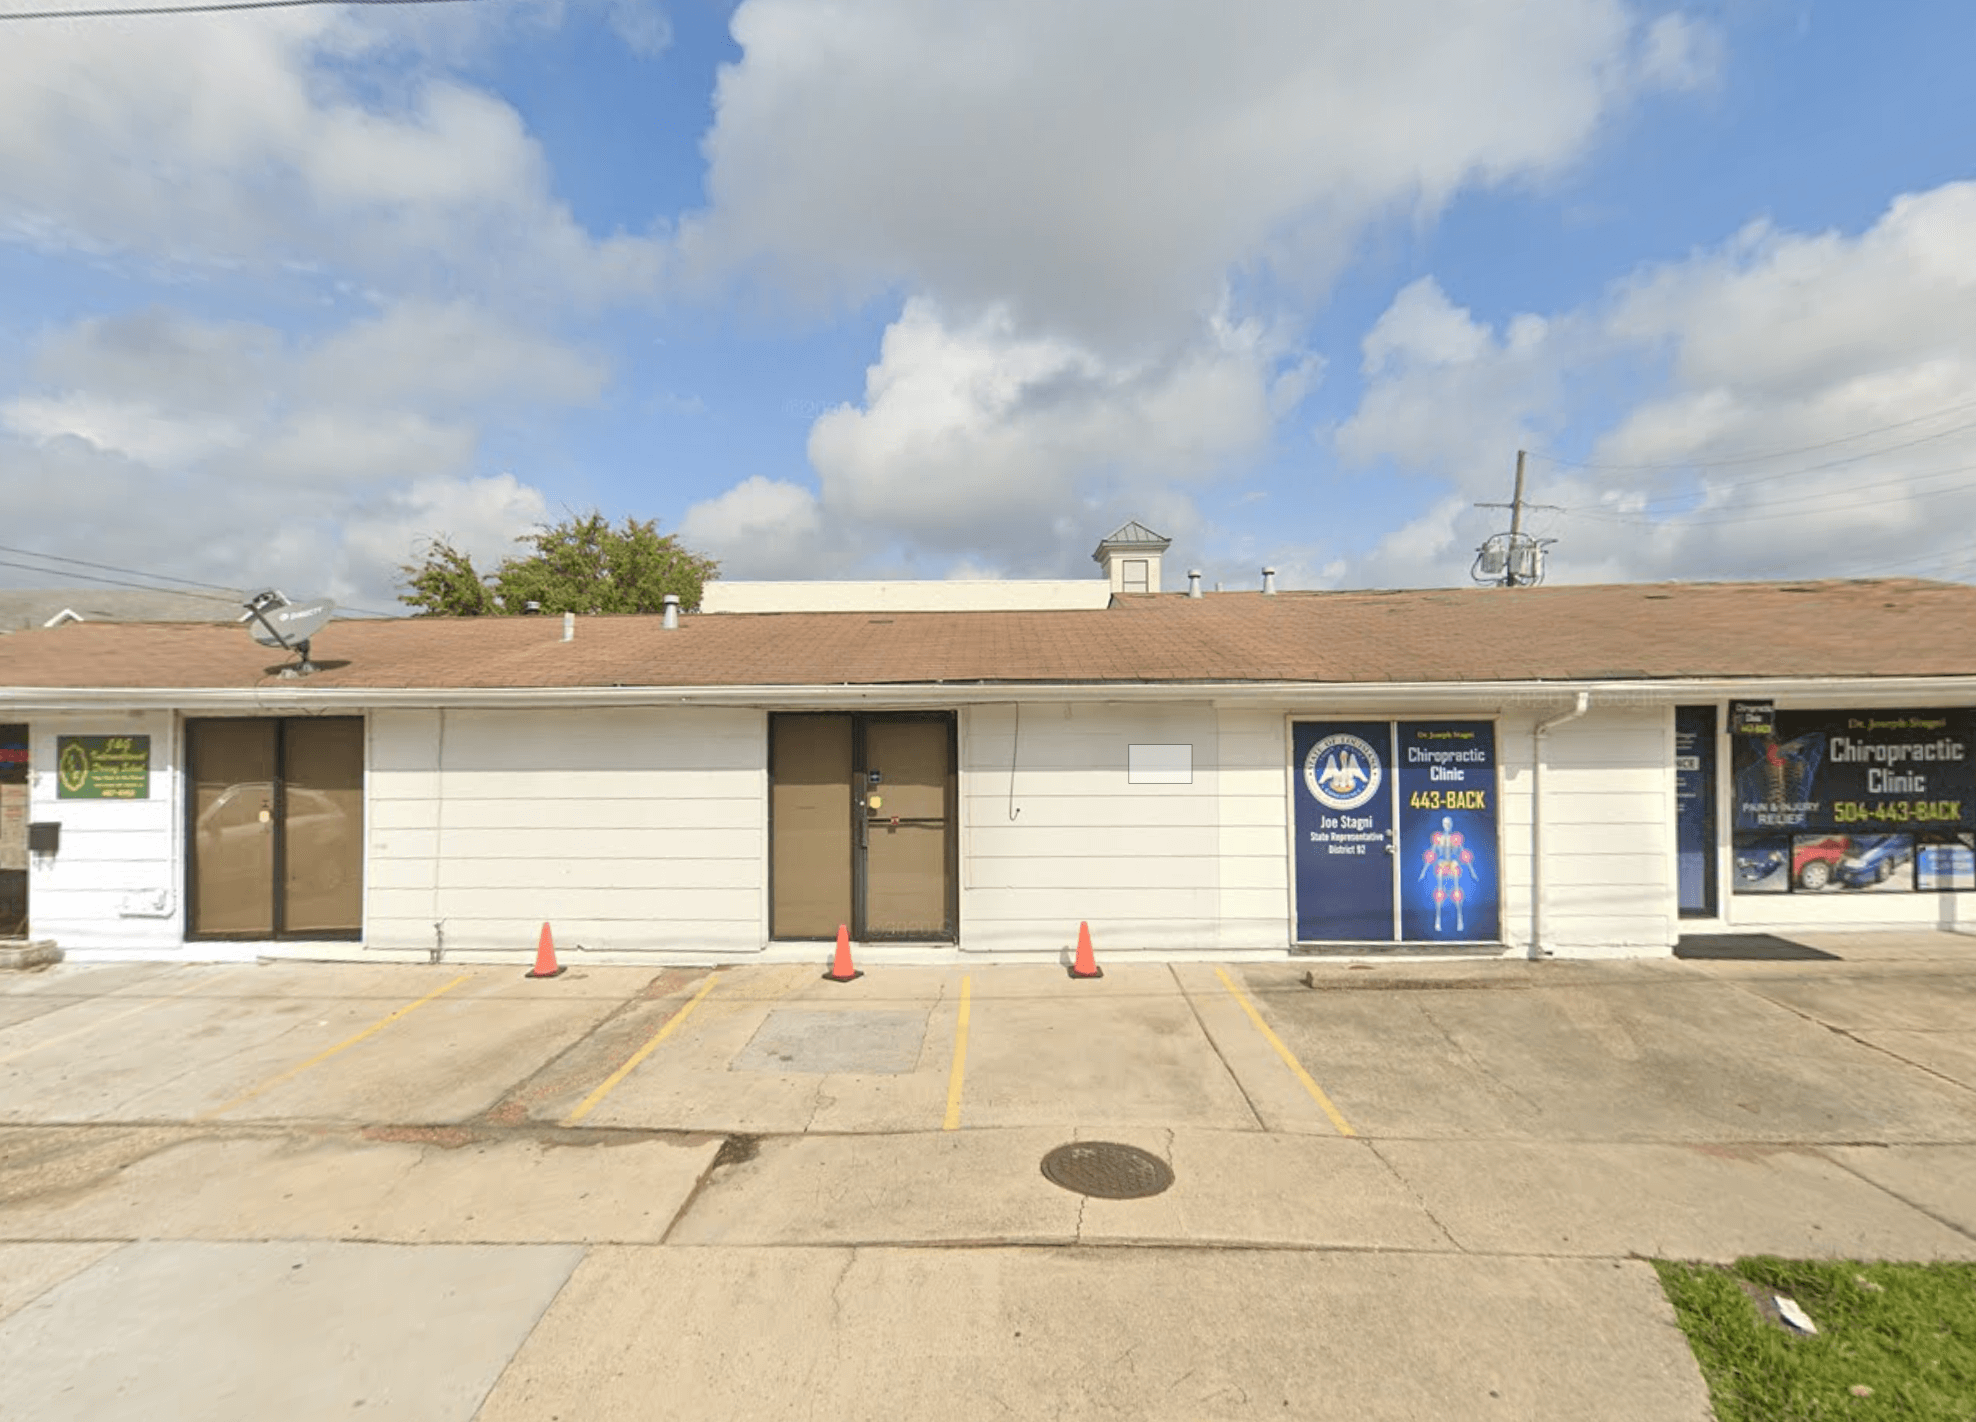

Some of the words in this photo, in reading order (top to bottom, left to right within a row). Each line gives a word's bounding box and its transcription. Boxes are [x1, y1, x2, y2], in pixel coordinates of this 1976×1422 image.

[1408, 746, 1486, 765] Chiropractic
[1829, 736, 1965, 767] Chiropractic
[1430, 766, 1465, 781] Clinic
[1868, 768, 1926, 793] Clinic
[1410, 790, 1486, 809] 443-BACK
[1757, 813, 1805, 825] RELIEF
[1833, 801, 1962, 822] 504-443-BACK
[1320, 814, 1338, 829] Joe
[1340, 814, 1373, 831] Stagni
[1310, 831, 1329, 841] State
[1330, 831, 1384, 843] Representative
